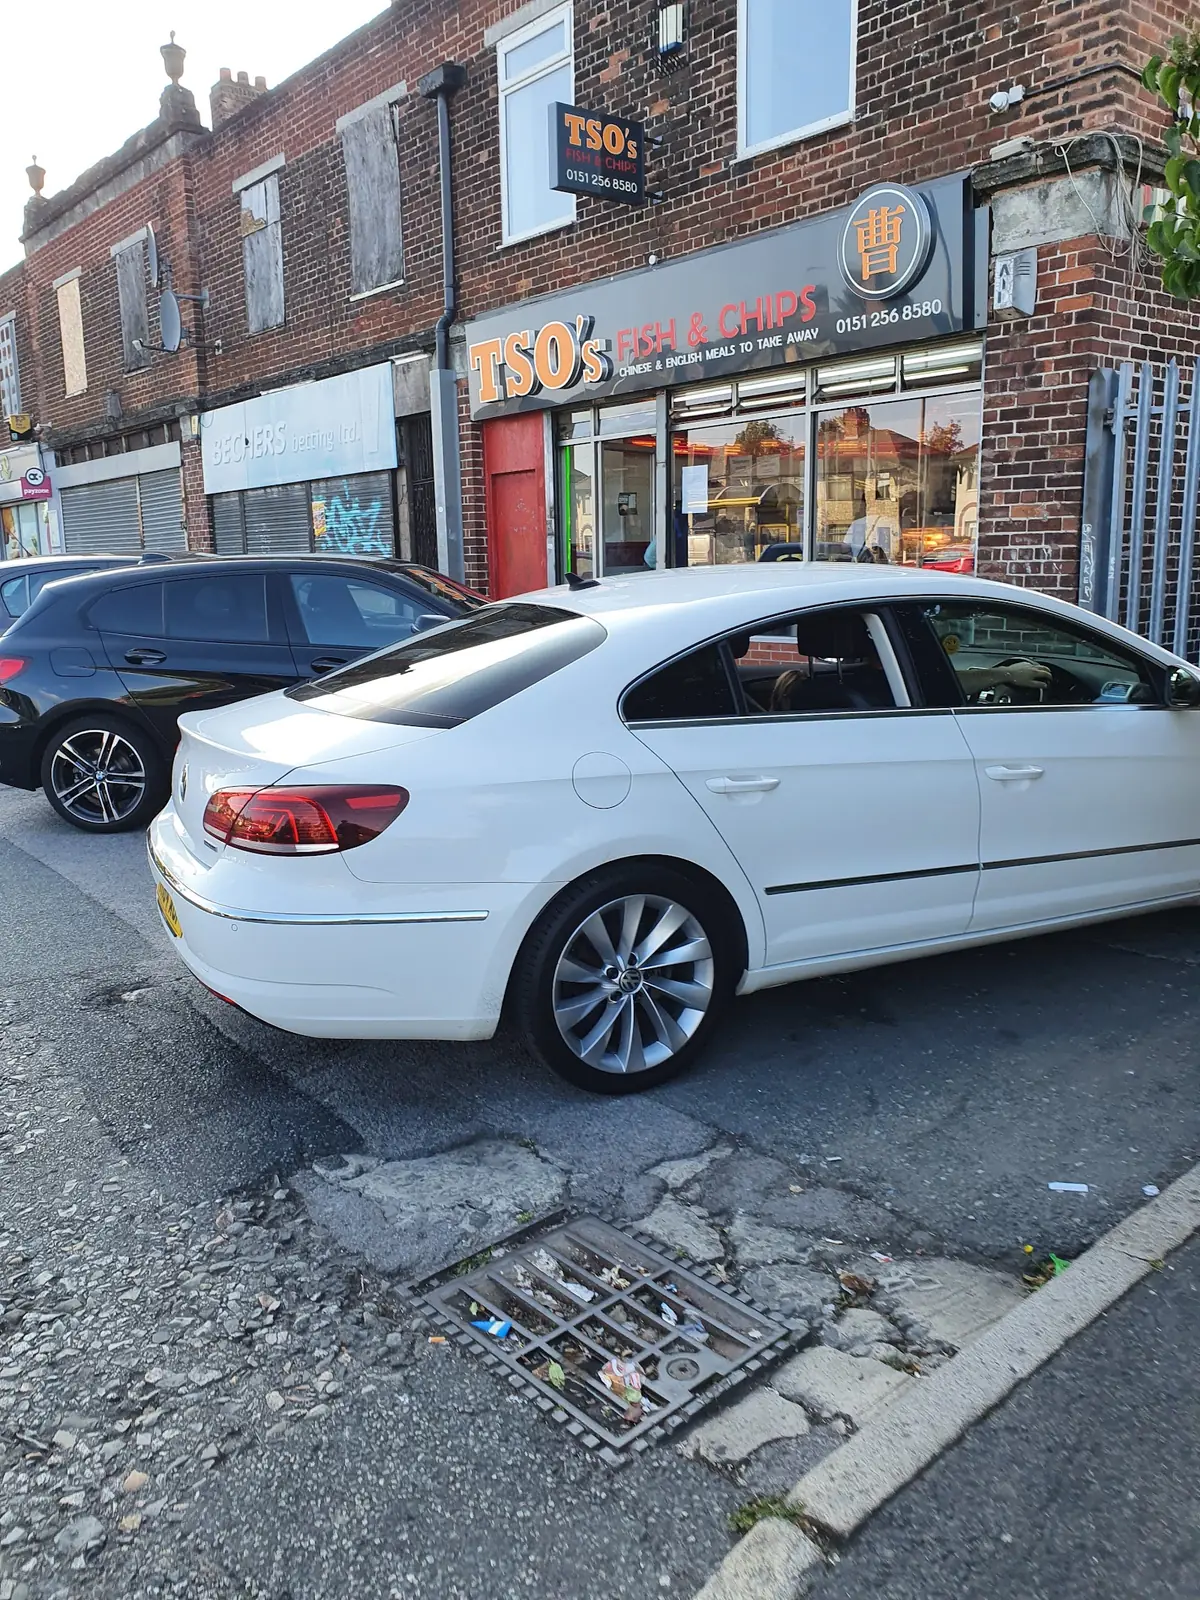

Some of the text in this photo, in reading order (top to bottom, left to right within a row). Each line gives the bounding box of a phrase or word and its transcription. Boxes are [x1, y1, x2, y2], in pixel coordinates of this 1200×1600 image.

[564, 113, 637, 159] TSO's
[565, 148, 591, 163] FISH
[605, 157, 637, 174] CHIPS
[566, 169, 638, 194] 0151 256 8580
[852, 205, 906, 281] 曹
[616, 284, 817, 362] FISH & CHIPS
[836, 299, 942, 334] 0151 256 8580
[469, 314, 604, 404] TSO's
[619, 328, 819, 378] CHINESE & ENGLISH MEALS TO TAKE AWAY
[212, 420, 287, 466] BECHERS
[292, 430, 335, 453] betting
